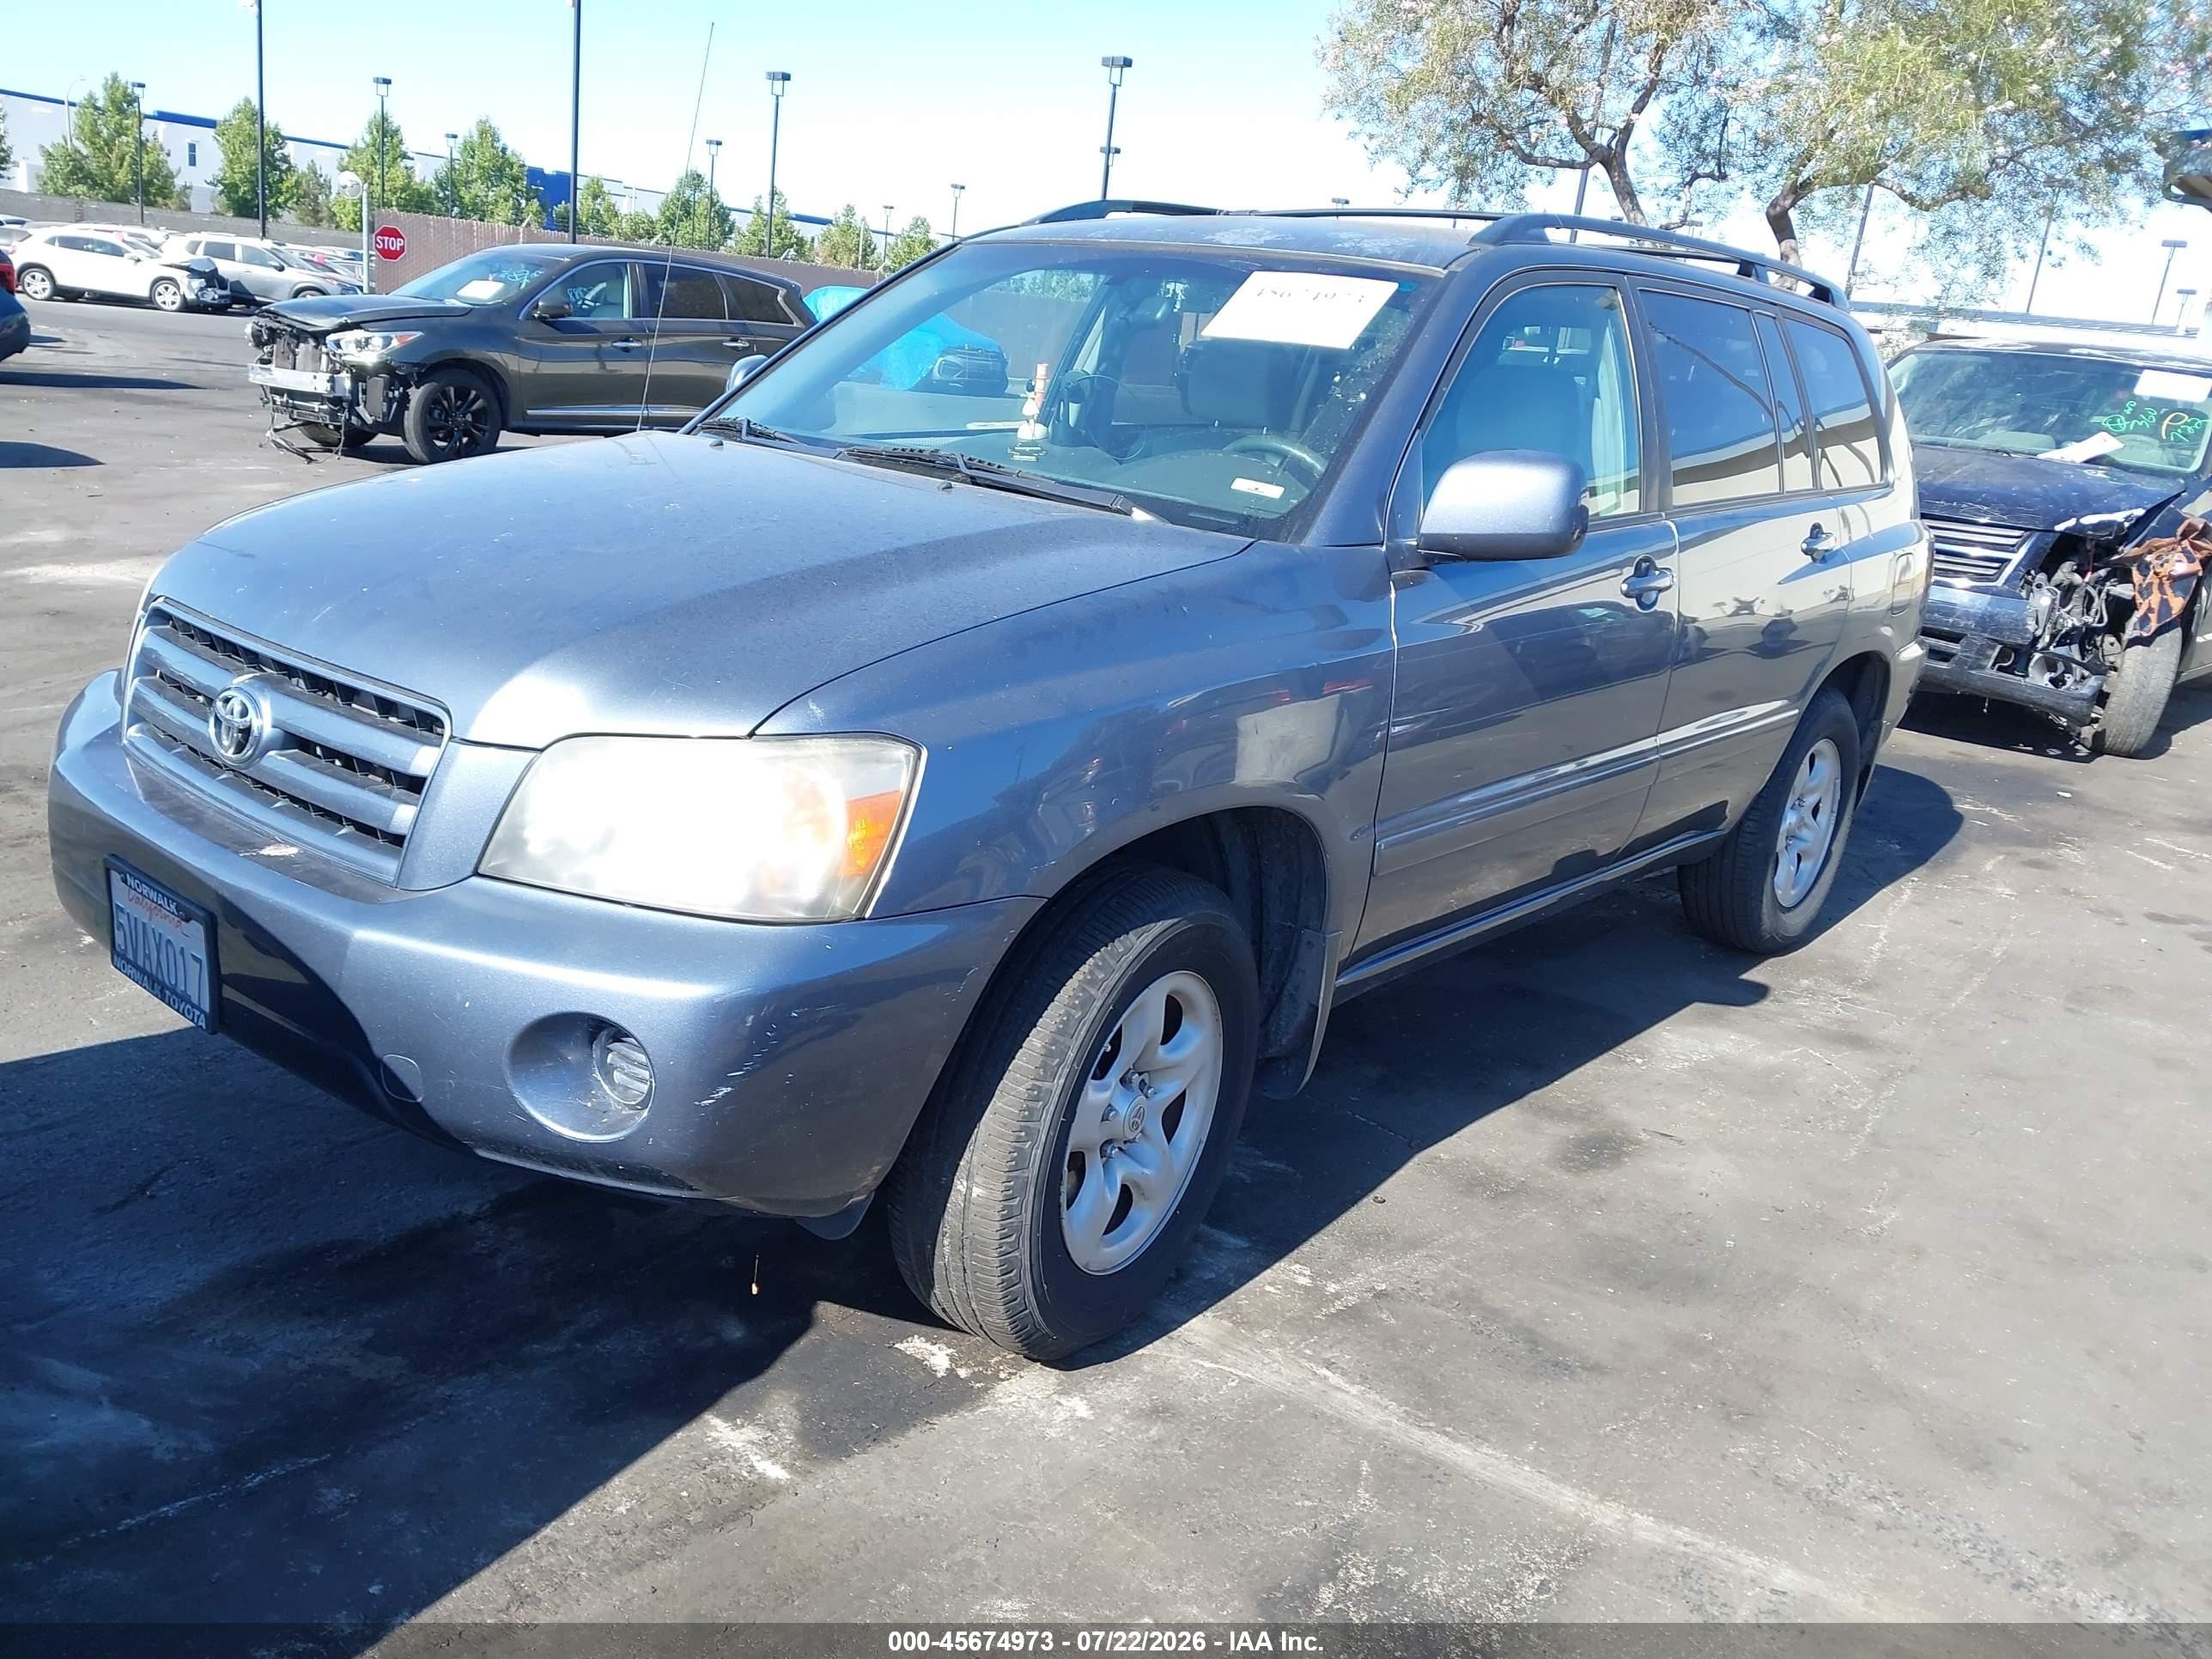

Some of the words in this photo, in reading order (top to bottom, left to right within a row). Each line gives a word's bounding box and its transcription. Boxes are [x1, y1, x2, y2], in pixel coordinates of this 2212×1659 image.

[376, 235, 404, 252] STOP
[126, 872, 179, 915] NORWALK
[115, 902, 203, 1006] 5VAX017
[113, 954, 162, 998] NORWALK
[164, 989, 207, 1030] TOYOTA
